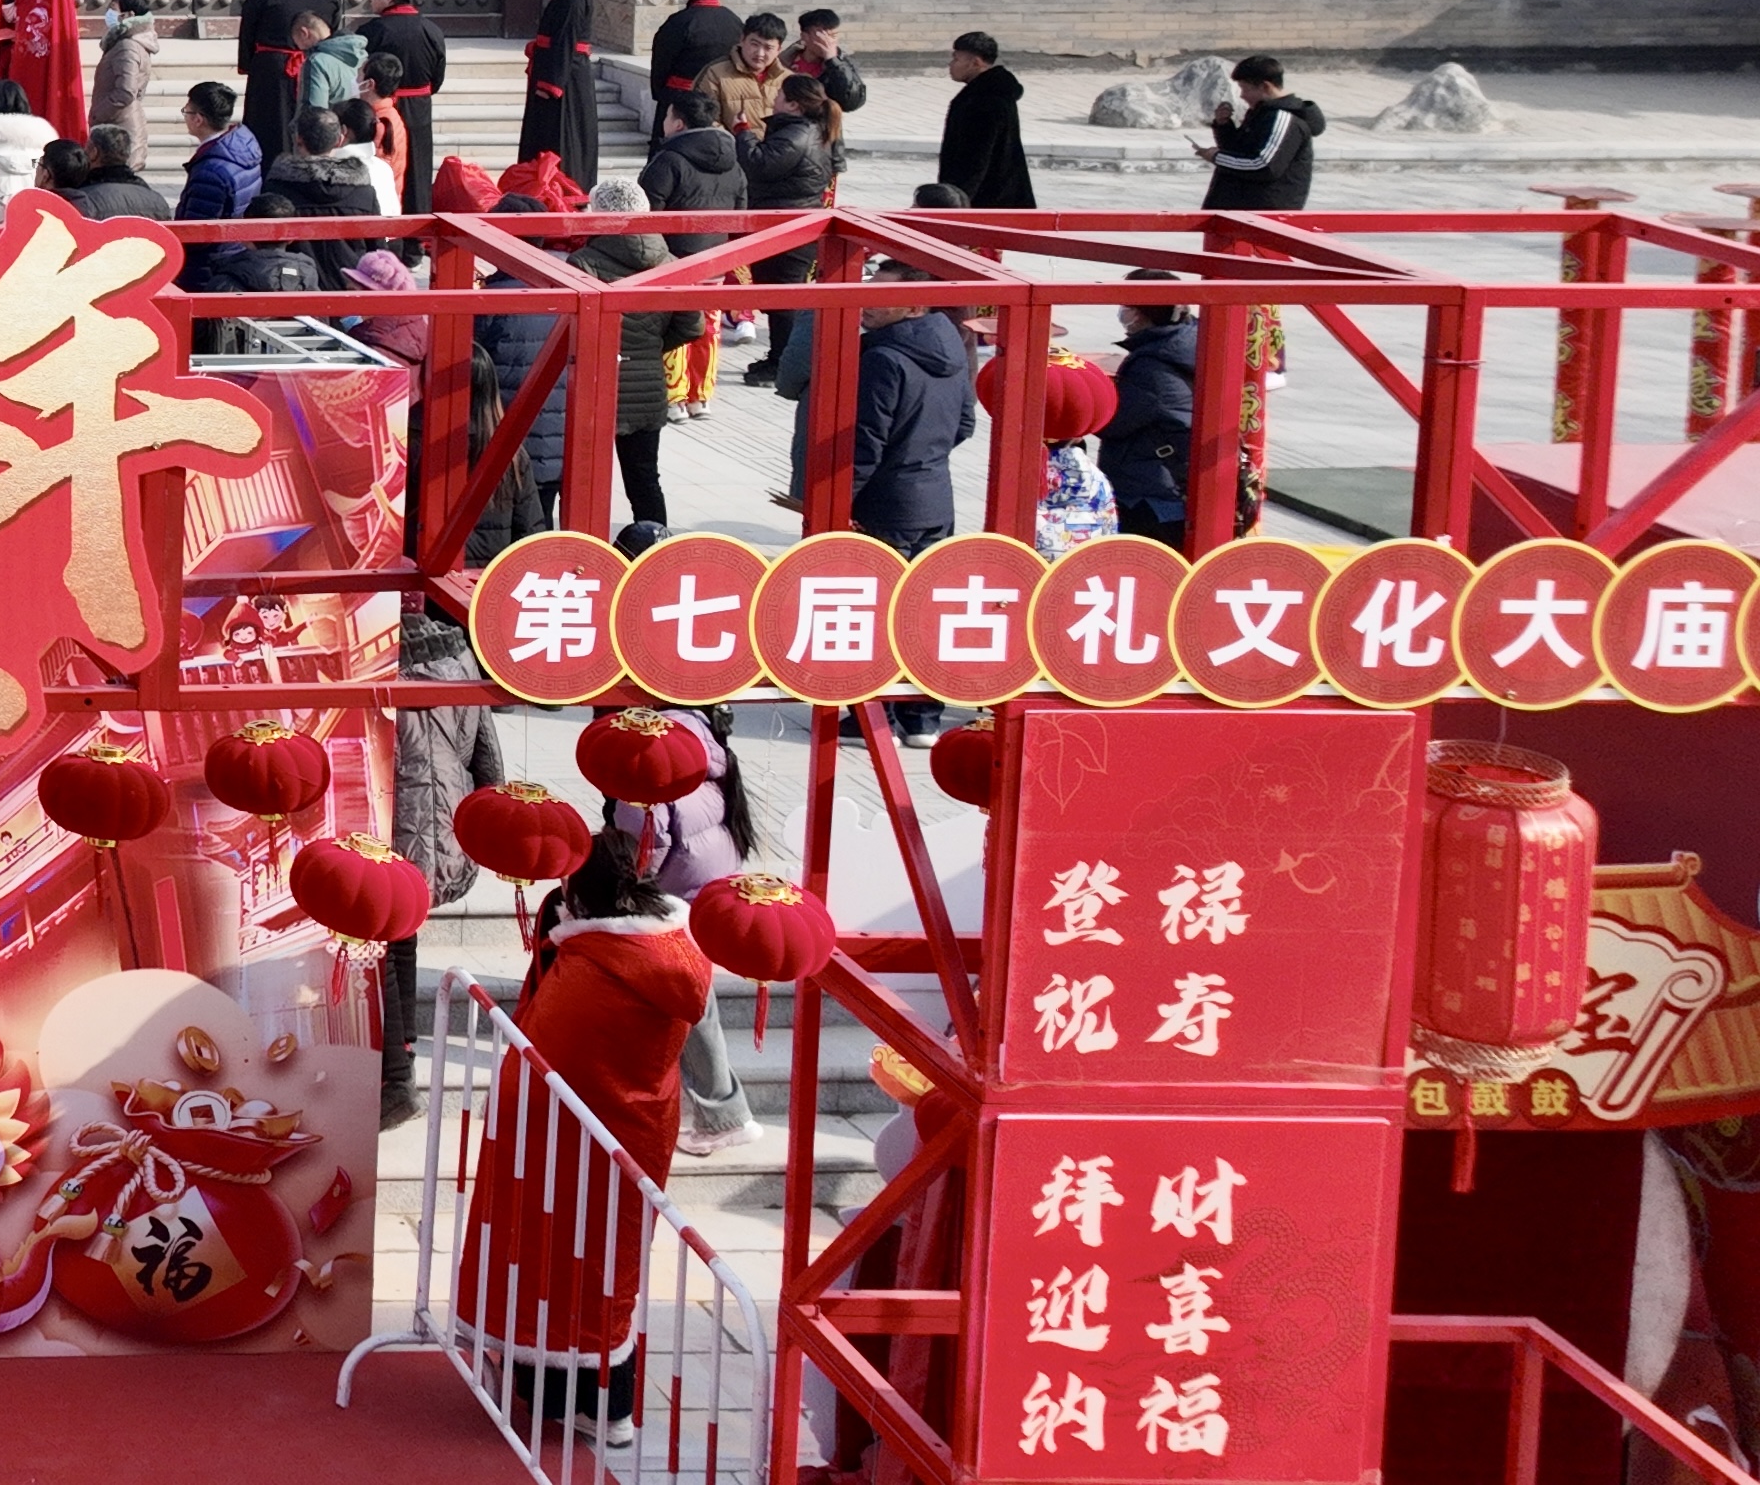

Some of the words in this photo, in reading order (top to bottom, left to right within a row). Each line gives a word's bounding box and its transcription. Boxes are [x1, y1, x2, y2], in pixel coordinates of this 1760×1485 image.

[508, 572, 1735, 673] 第七届古礼文化大庙
[131, 1216, 212, 1303] 福
